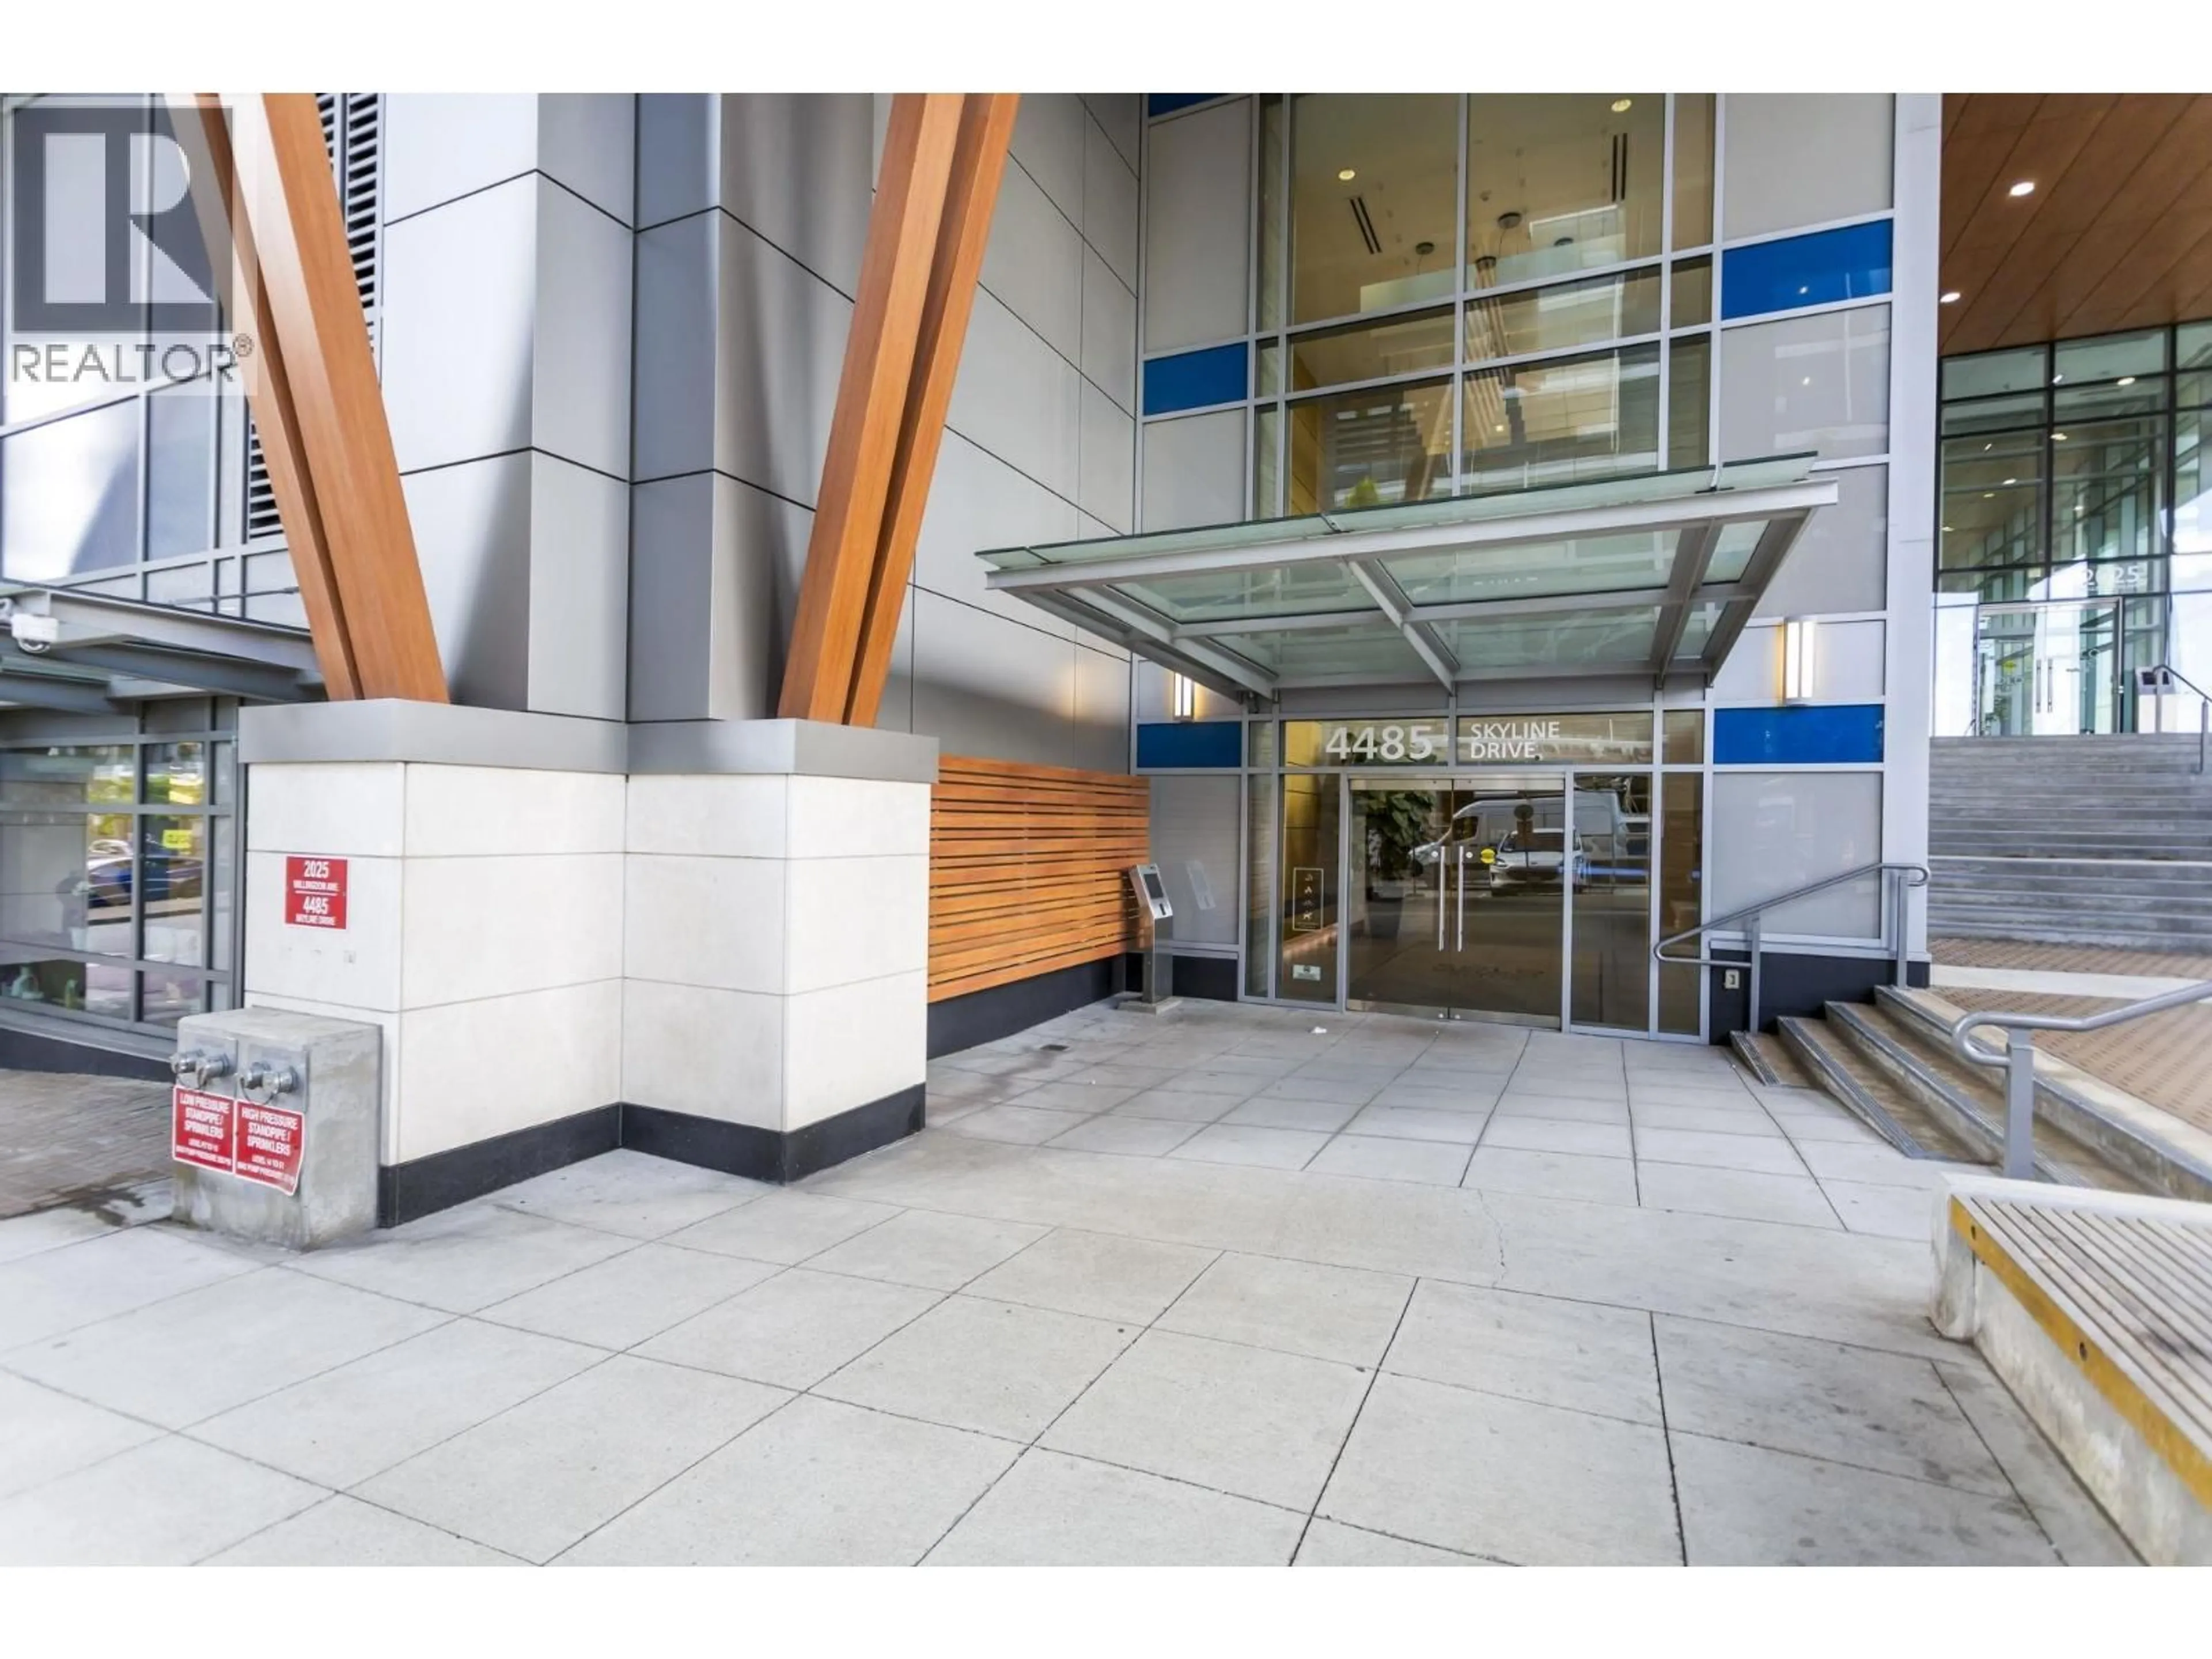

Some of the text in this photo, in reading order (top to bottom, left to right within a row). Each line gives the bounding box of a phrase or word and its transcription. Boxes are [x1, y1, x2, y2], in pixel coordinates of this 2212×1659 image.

[1471, 722, 1560, 739] SKYLINE
[1326, 725, 1433, 760] 4485
[1471, 742, 1537, 759] DRIVE
[304, 860, 329, 878] 2025
[302, 896, 329, 915] 4485
[260, 1111, 298, 1130] PRESSURE
